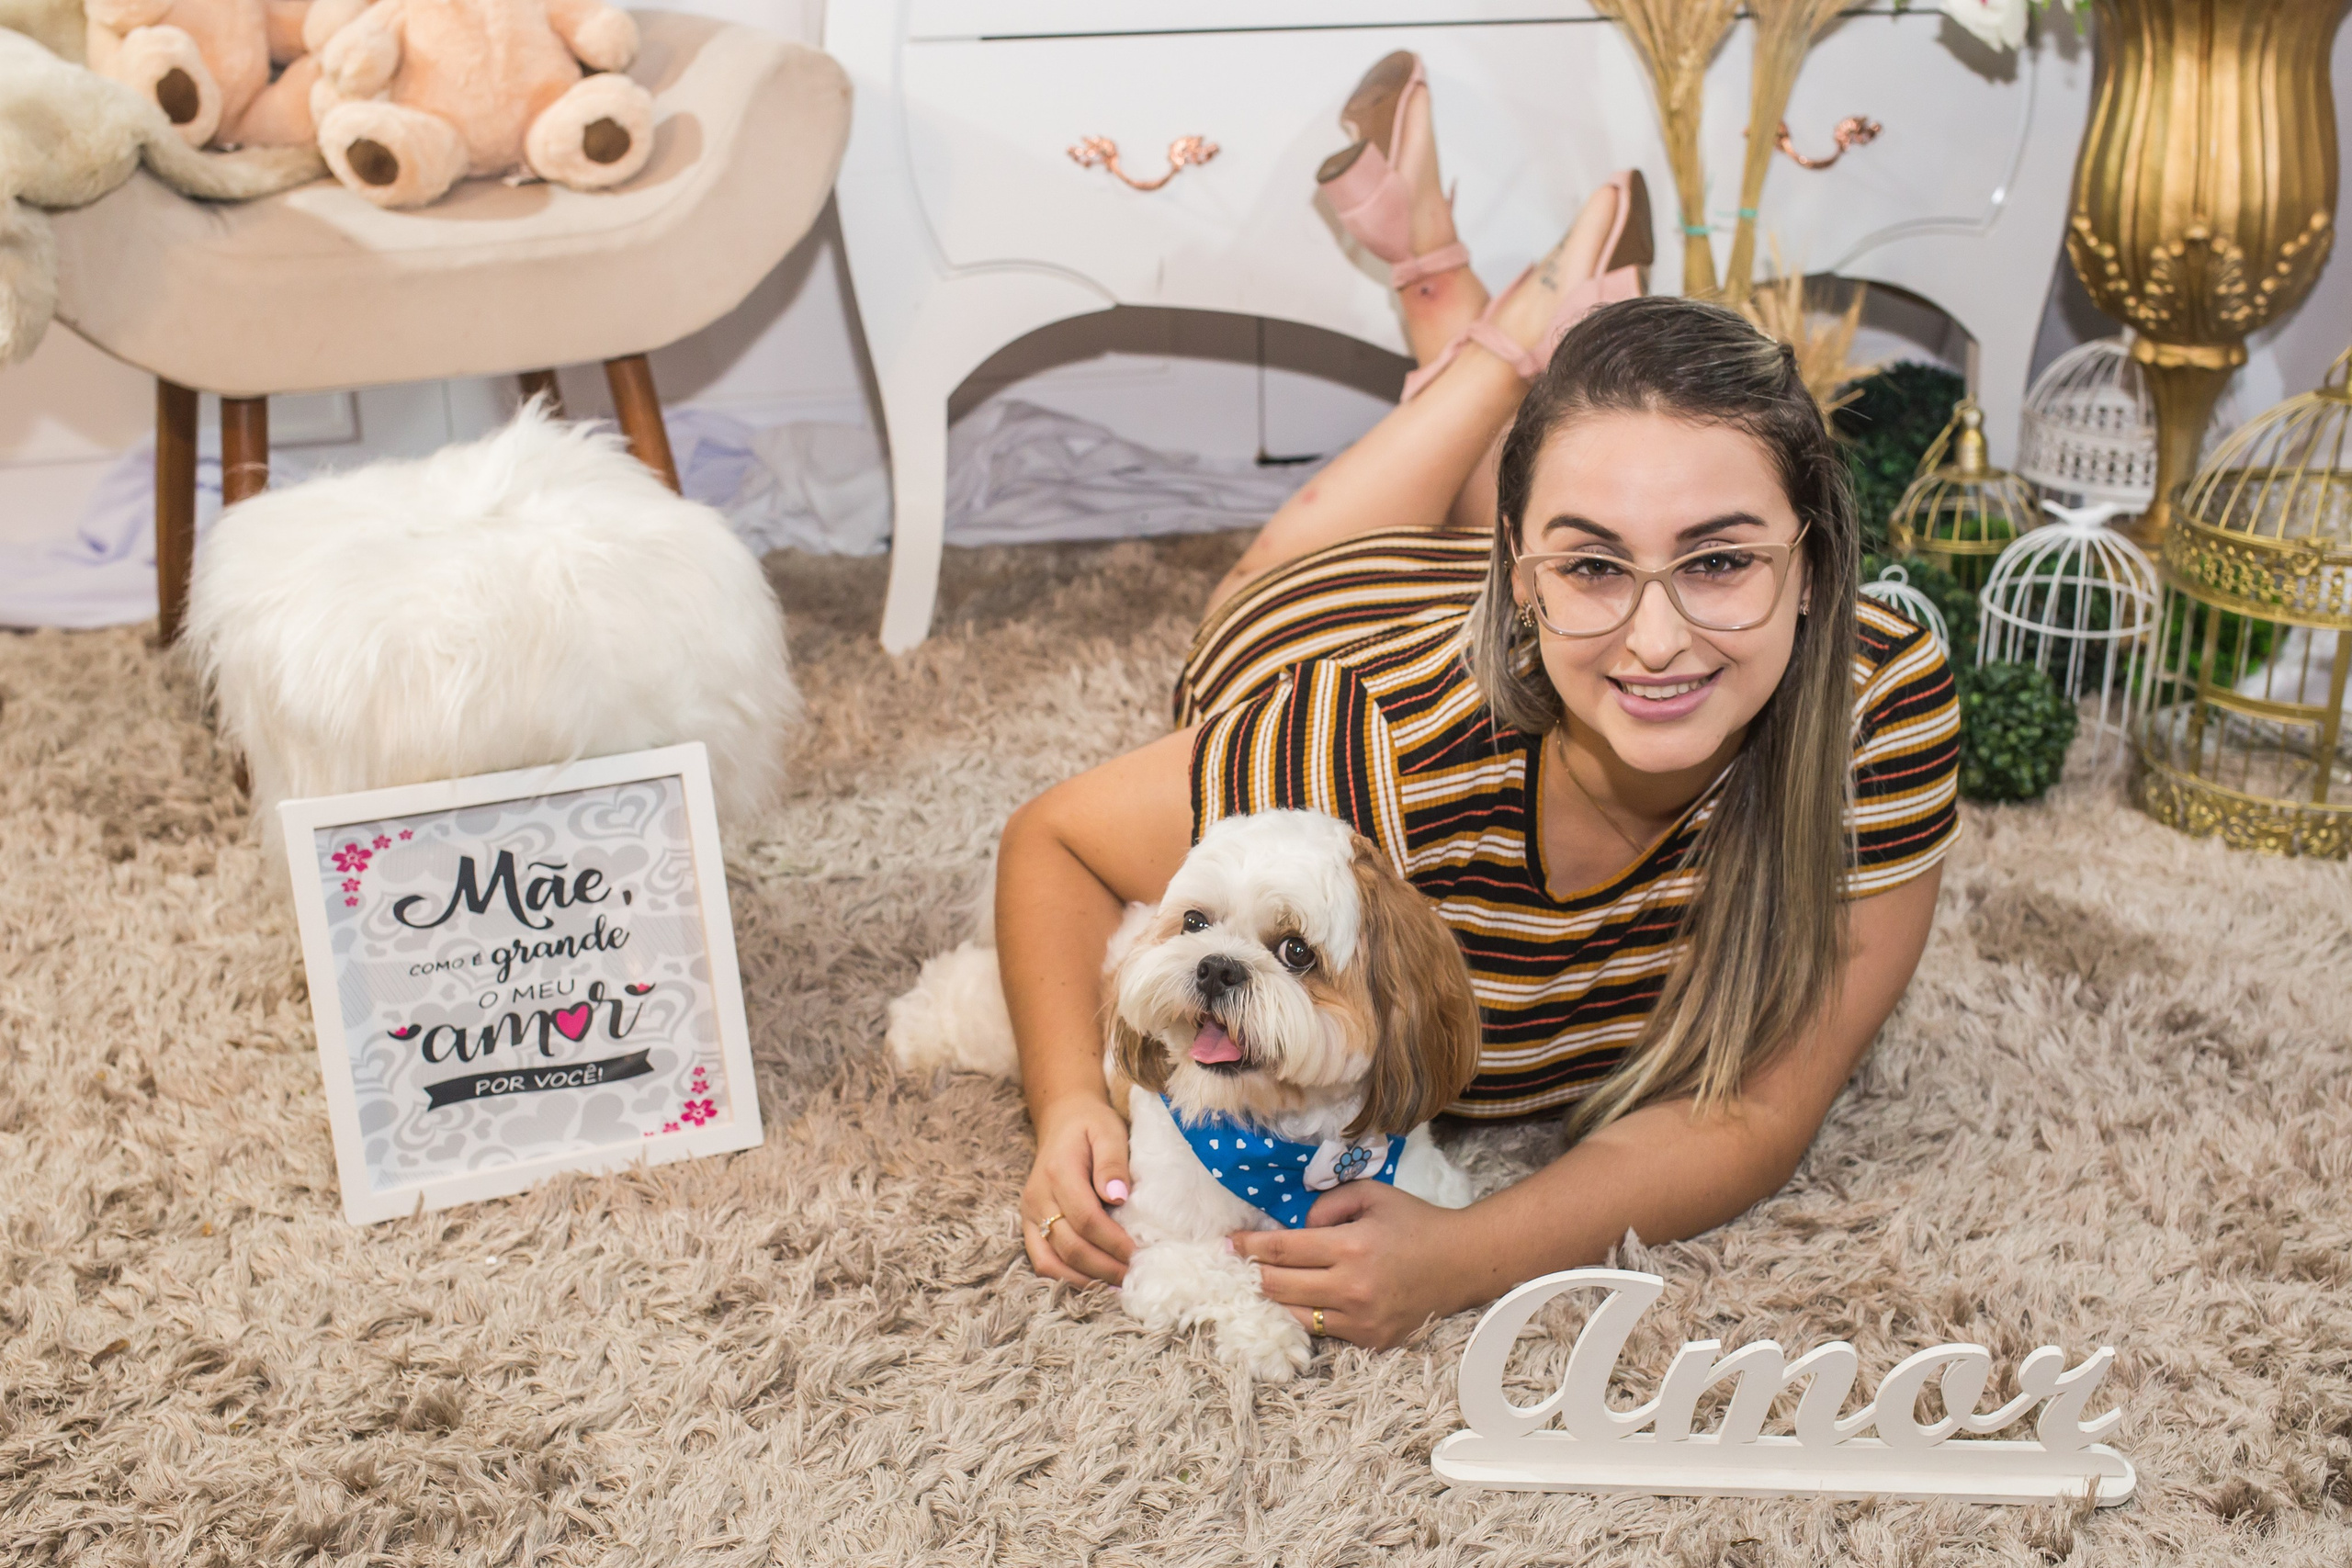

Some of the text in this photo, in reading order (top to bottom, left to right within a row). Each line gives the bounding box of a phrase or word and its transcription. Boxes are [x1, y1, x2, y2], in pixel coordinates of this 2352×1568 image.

[393, 850, 632, 930] Mãe,
[409, 957, 465, 977] COMO
[491, 913, 630, 984] grande
[478, 978, 575, 1010] O MEU
[474, 1063, 605, 1097] POR VOCÊ!
